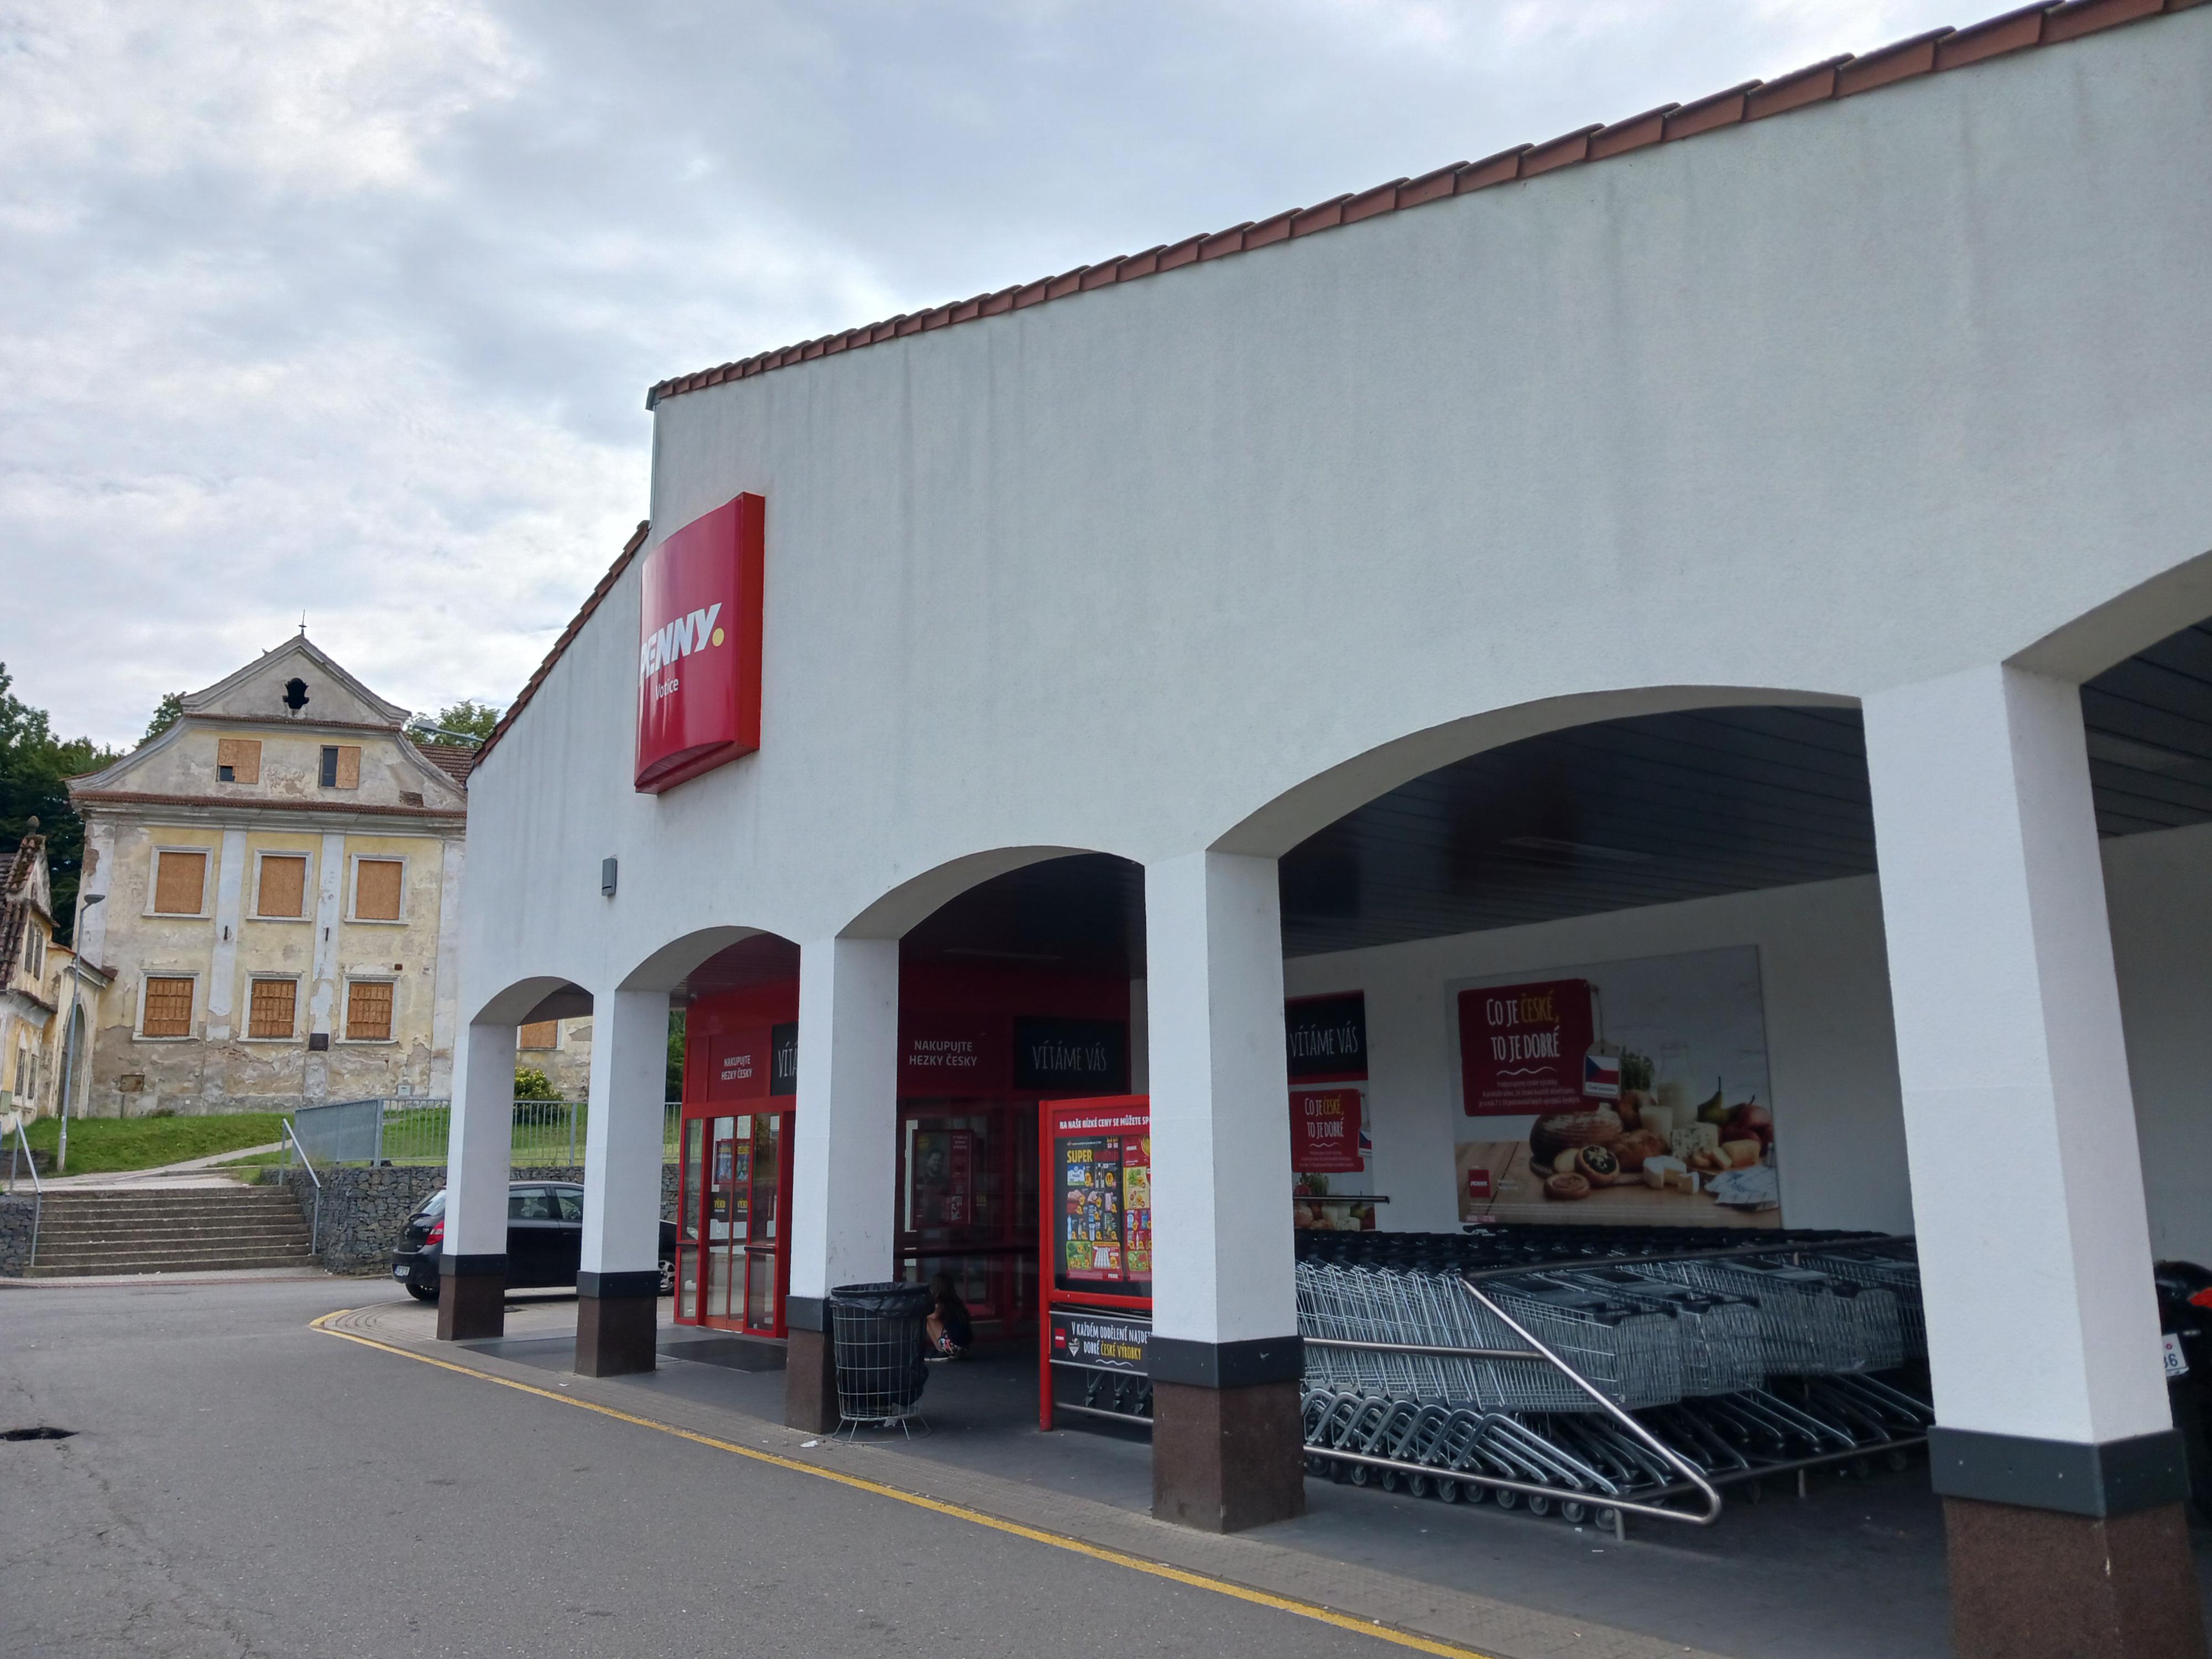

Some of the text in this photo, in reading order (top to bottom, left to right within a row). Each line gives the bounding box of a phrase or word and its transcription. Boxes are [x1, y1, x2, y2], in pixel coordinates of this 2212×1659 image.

[656, 677, 679, 701] Votice
[1506, 999, 1519, 1027] JE
[1520, 989, 1559, 1024] ČESKÉ,
[914, 1040, 973, 1053] NAKUPUJTE
[1289, 1020, 1358, 1058] VÍTÁME VÁS
[1490, 1025, 1561, 1063] TO JE DOBRÉ
[724, 1055, 752, 1067] NAKUPUJTE
[909, 1053, 978, 1066] HEZKY ČESKY
[1032, 1040, 1107, 1071] VÍTÁME VÁS
[721, 1068, 753, 1080] HEZKY ČESKY
[1315, 1098, 1323, 1117] JE
[1068, 1118, 1082, 1129] NAŠE
[1098, 1118, 1112, 1128] CENY
[1120, 1114, 1141, 1126] MŮŽETE
[1142, 1117, 1150, 1125] SP
[1307, 1117, 1344, 1139] TO JE DOBRÉ
[1066, 1149, 1093, 1164] SUPER
[1071, 1321, 1076, 1335] V
[1077, 1322, 1099, 1338] KAŽDÉM
[1100, 1325, 1128, 1341] ODDĚLENÍ
[1083, 1340, 1142, 1360] DOBRÉ ČESKÉ VÝROBKY
